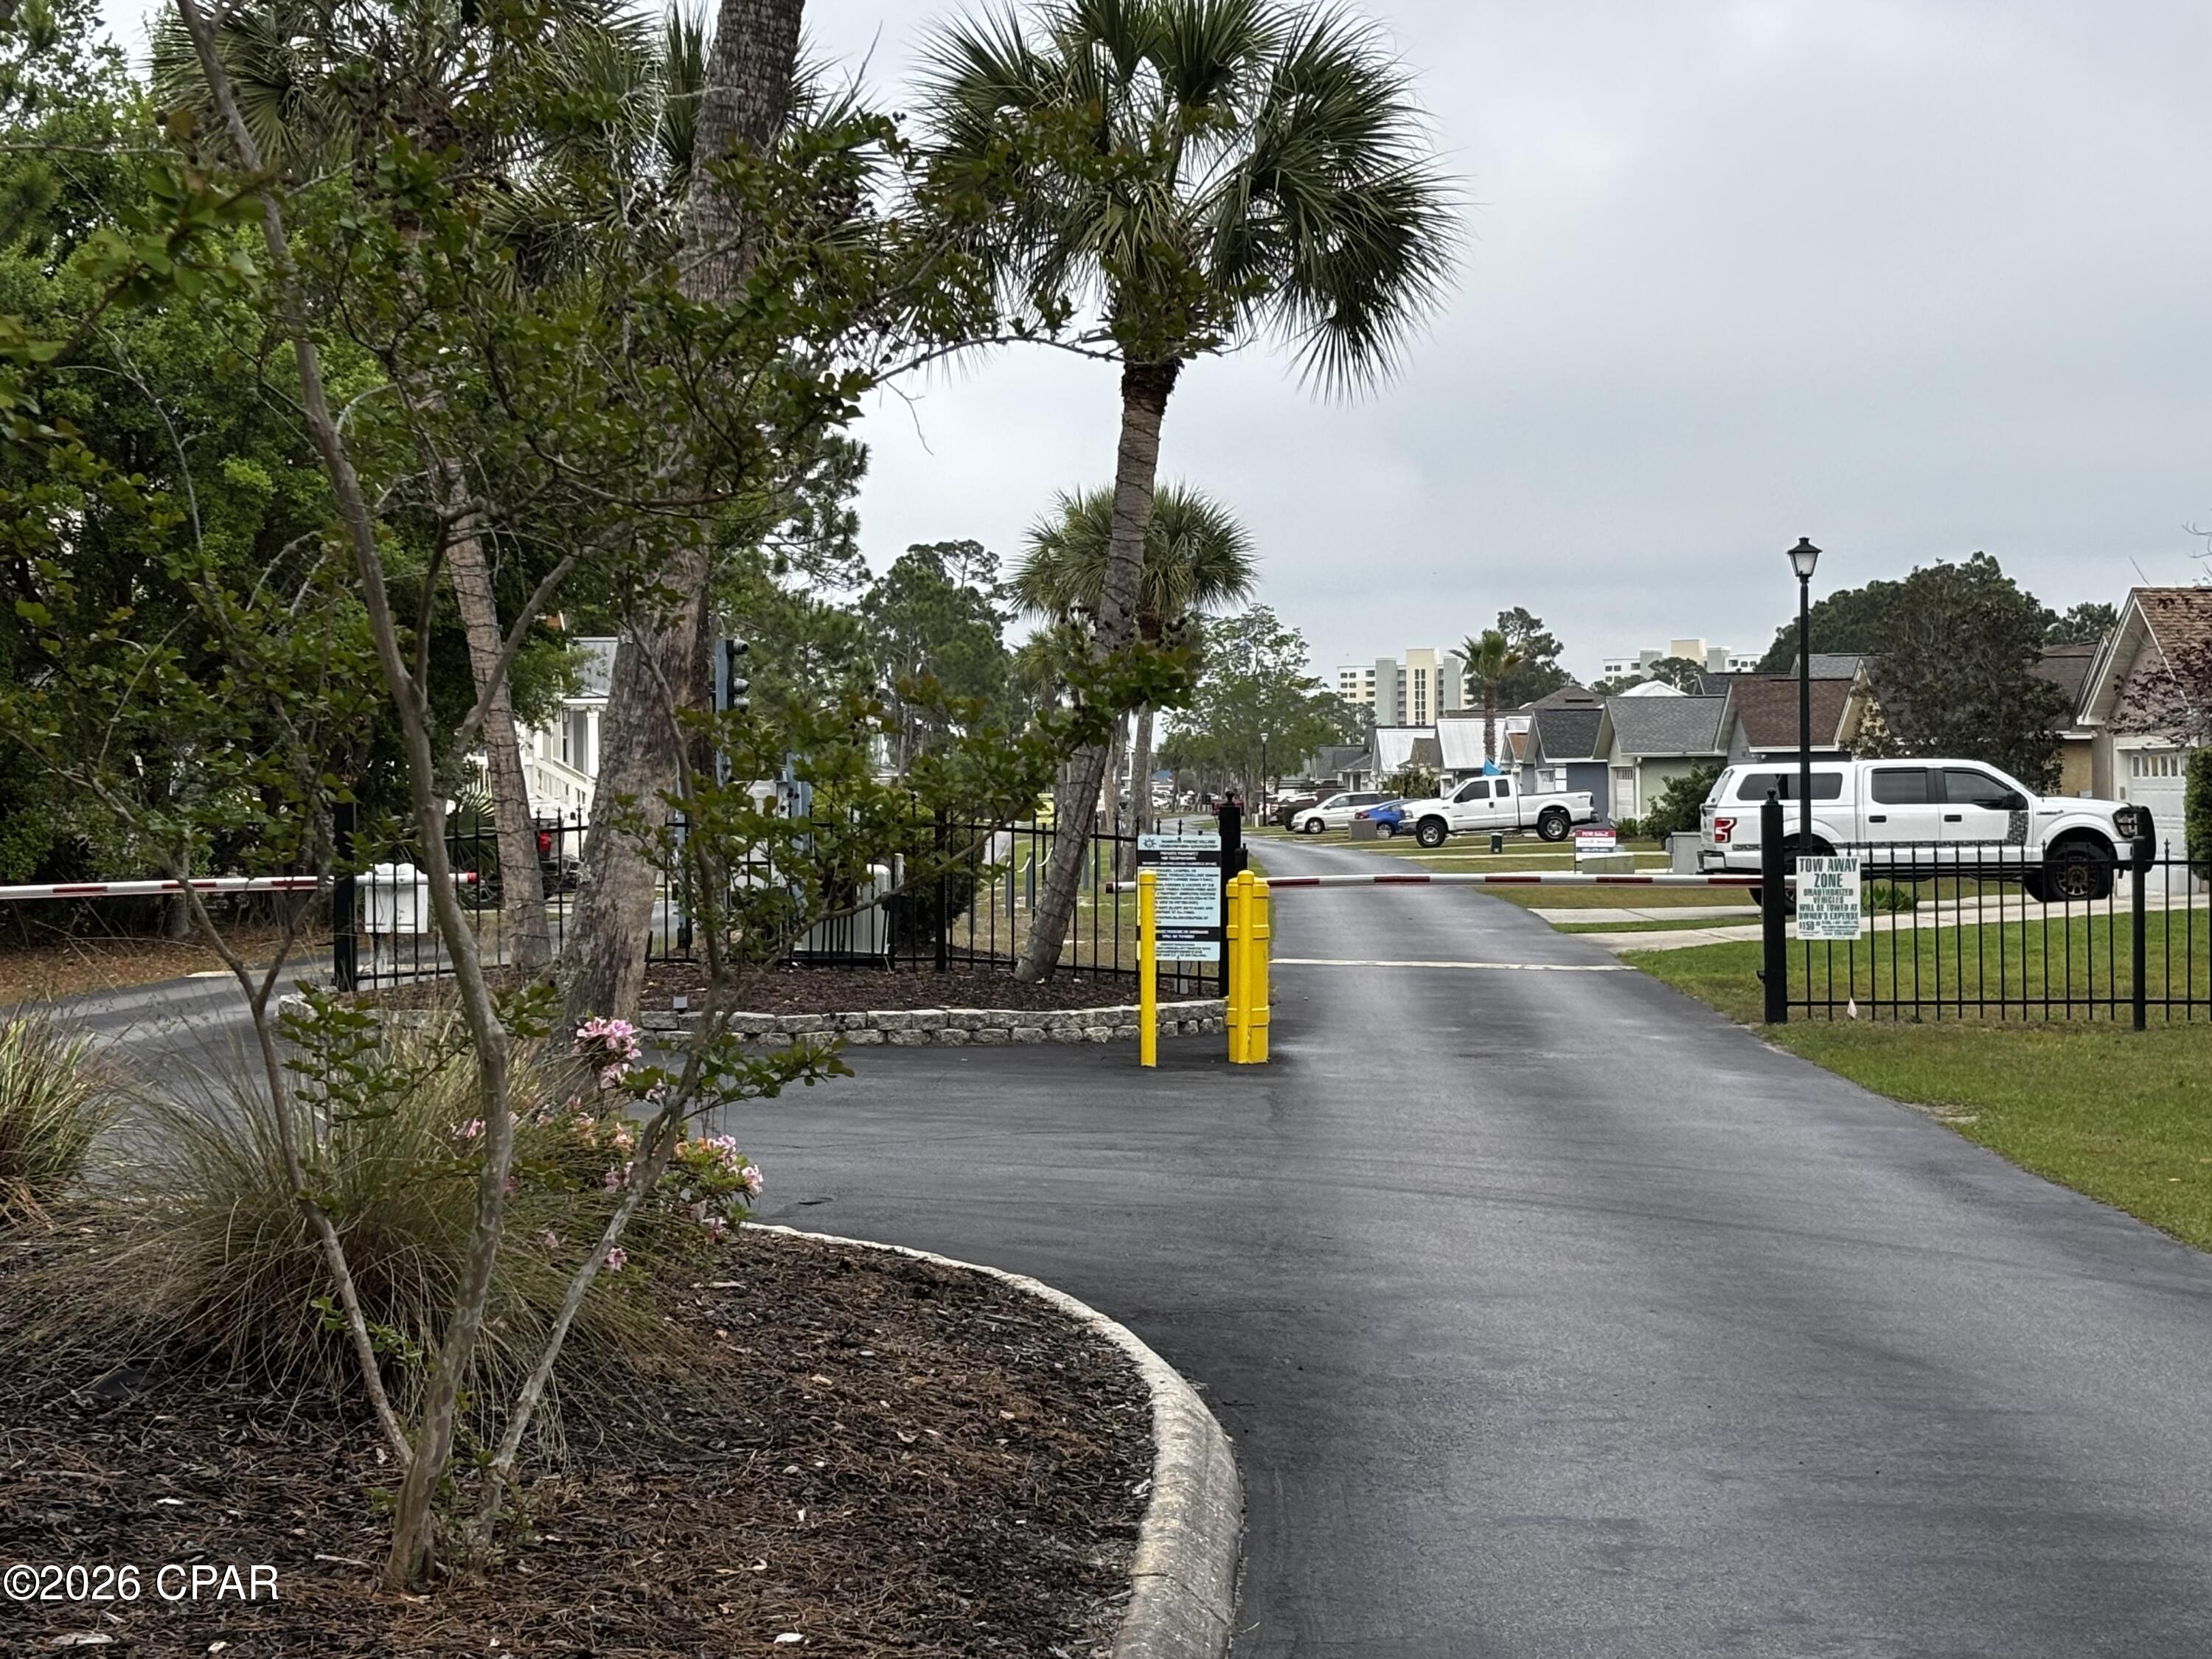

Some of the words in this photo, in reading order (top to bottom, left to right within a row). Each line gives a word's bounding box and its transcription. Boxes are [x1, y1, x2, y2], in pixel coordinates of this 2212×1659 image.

[1799, 858, 1823, 872] TOW
[1828, 858, 1857, 872] AWAY
[1814, 873, 1843, 888] ZONE
